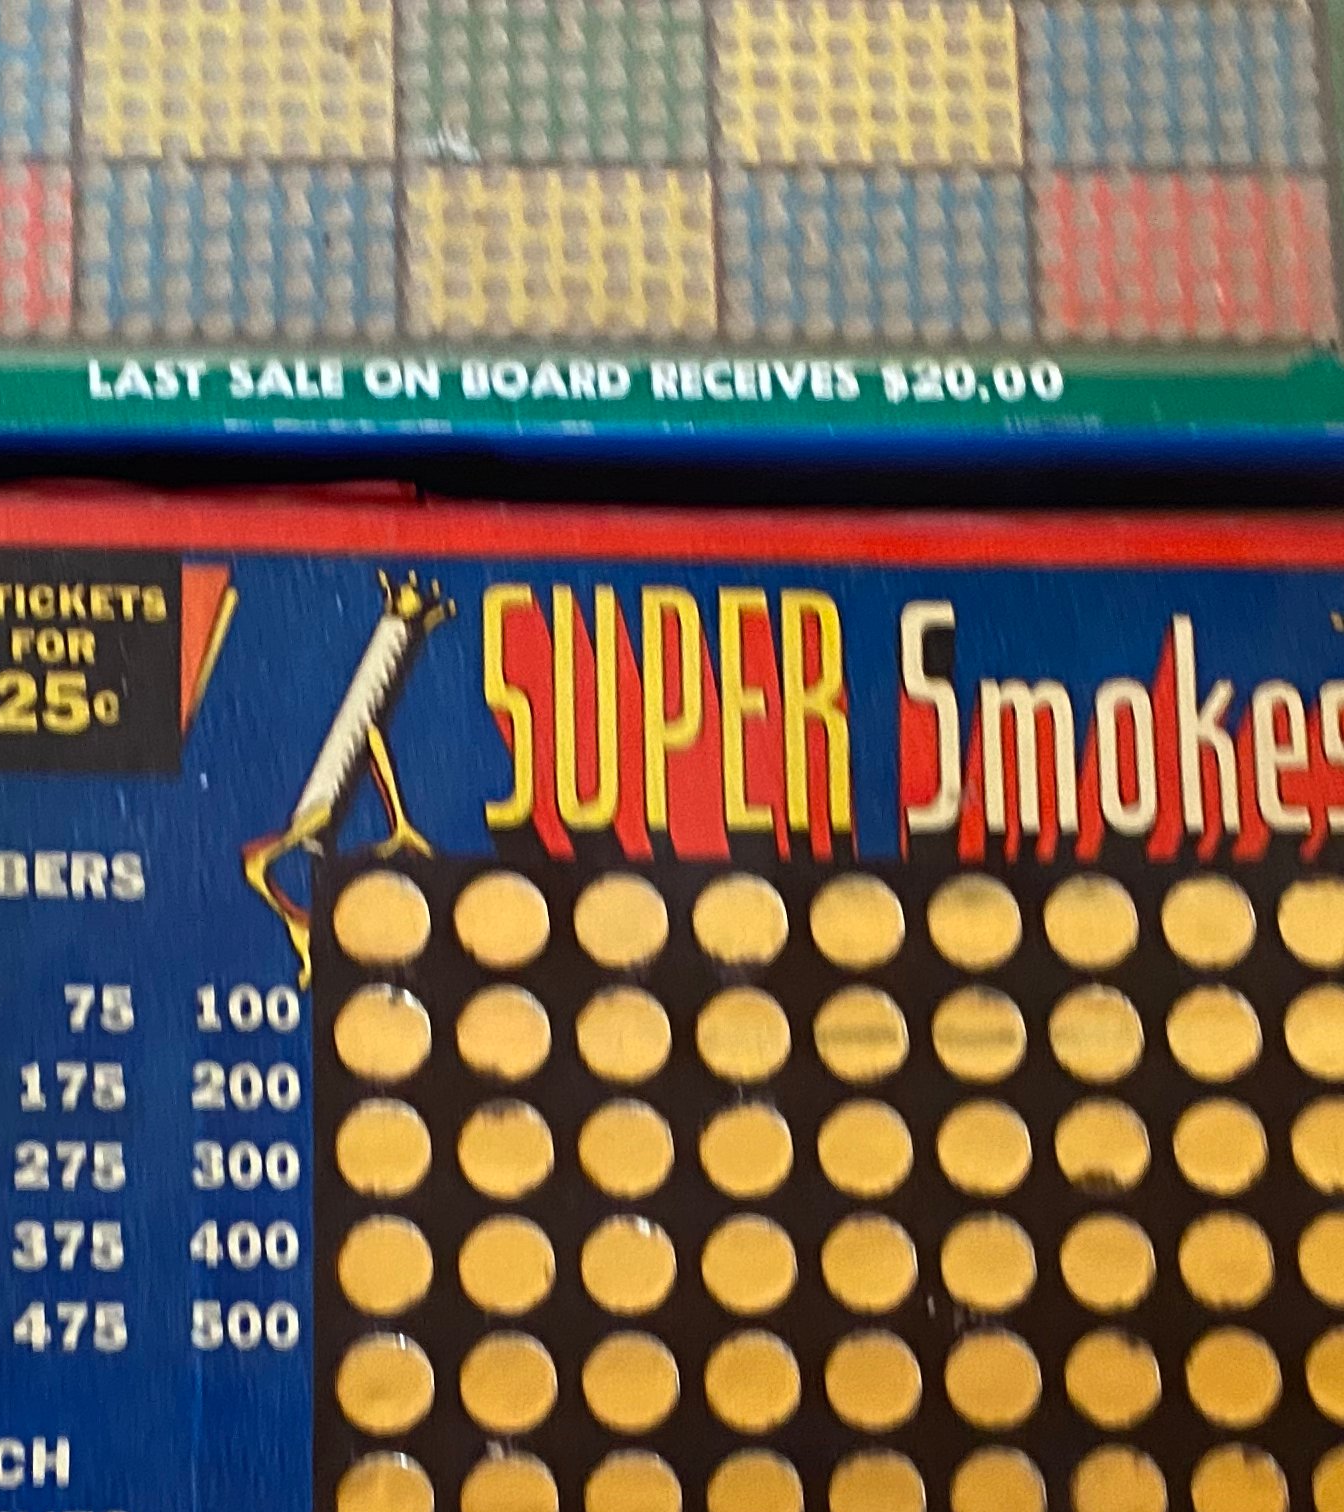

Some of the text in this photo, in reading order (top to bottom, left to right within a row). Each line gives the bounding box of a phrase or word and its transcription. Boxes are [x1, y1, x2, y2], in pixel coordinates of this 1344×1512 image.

[89, 358, 1064, 404] LAST SALE ON BOARD RECEIVES $20.00
[11, 627, 96, 666] FOR
[482, 582, 853, 835] SUPER
[64, 984, 134, 1033] 75
[197, 984, 300, 1033] 100
[20, 1061, 126, 1112] 175
[191, 1061, 301, 1111] 200
[14, 1140, 126, 1192] 275
[192, 1141, 300, 1191] 300
[12, 1220, 125, 1271] 375
[190, 1220, 299, 1270] 400
[13, 1301, 128, 1352] 475
[191, 1300, 300, 1351] 500
